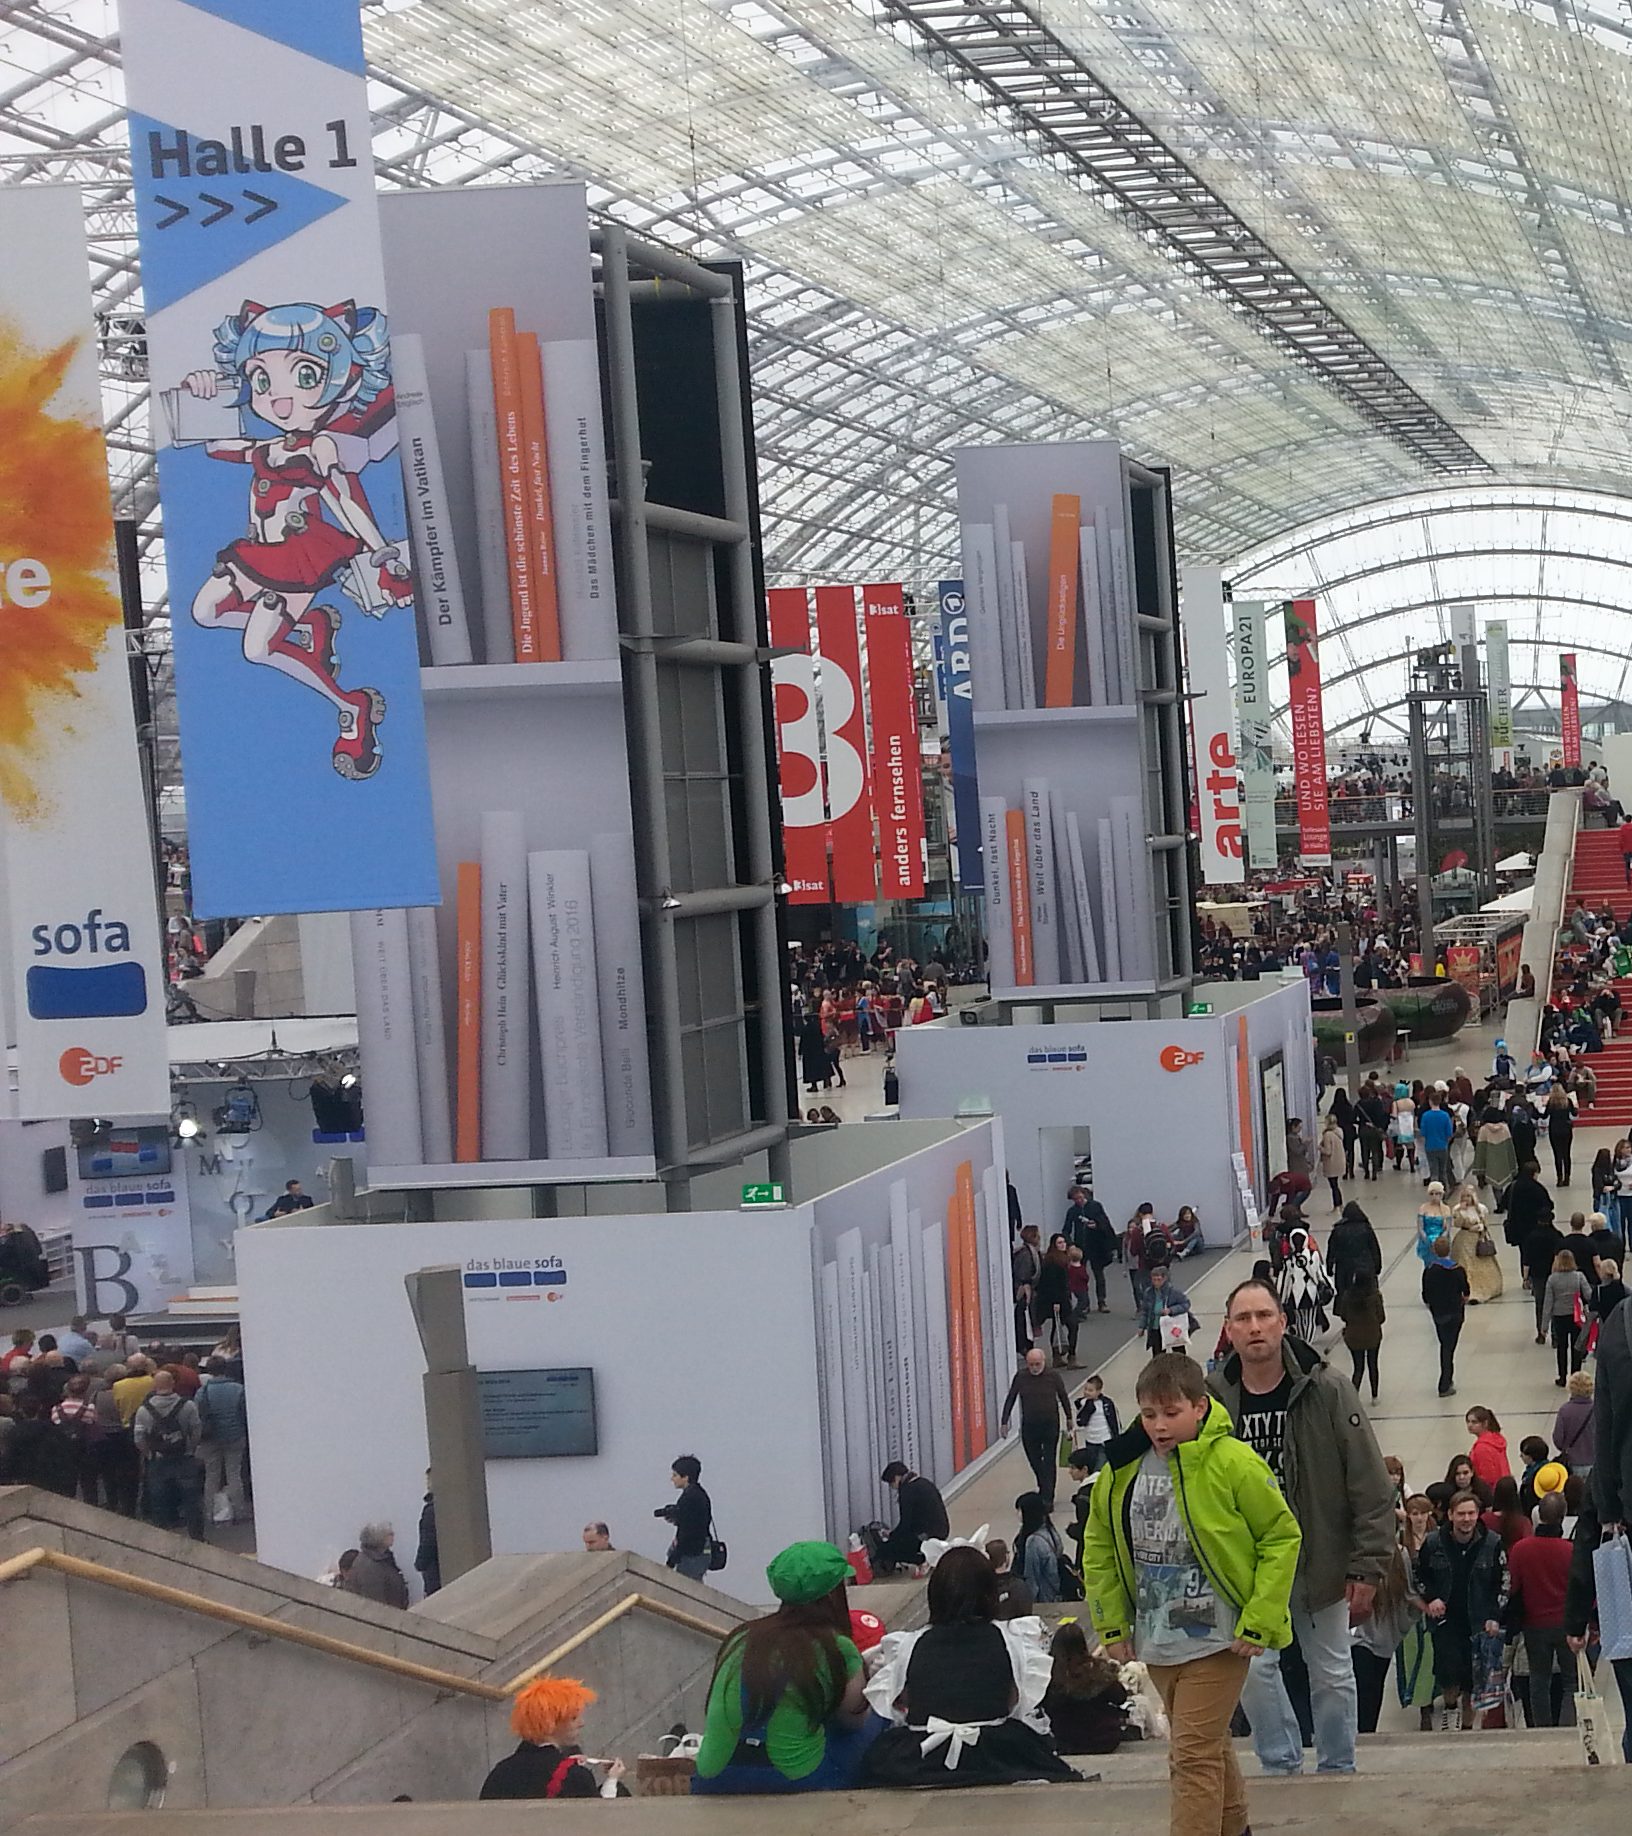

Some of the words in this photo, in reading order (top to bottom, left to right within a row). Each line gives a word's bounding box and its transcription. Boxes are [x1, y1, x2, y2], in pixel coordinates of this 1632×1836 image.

[148, 125, 306, 179] Halle
[326, 119, 358, 169] 1
[506, 411, 518, 452] Lebens
[576, 416, 590, 471] Fingerhut
[412, 437, 430, 497] Vatikan
[510, 454, 519, 474] des
[510, 479, 520, 502] Zeit
[580, 474, 592, 499] dem
[420, 500, 434, 522] im
[582, 502, 593, 521] mit
[514, 503, 525, 553] schönste
[425, 524, 447, 594] Kämpfer
[516, 555, 527, 572] die
[586, 525, 599, 575] Mädchen
[516, 573, 528, 588] ist
[588, 578, 600, 600] Das
[438, 599, 452, 626] Der
[517, 591, 532, 632] Jugend
[520, 634, 533, 653] Die
[1238, 615, 1257, 704] EUROPA21
[1295, 704, 1308, 745] LESEN
[1306, 686, 1322, 759] LIEBSTEN?
[1493, 687, 1509, 743] BÜCHER
[887, 735, 904, 818] fernsehen
[1298, 748, 1310, 775] WO
[1311, 761, 1323, 785] AM
[1030, 791, 1040, 818] Land
[1206, 731, 1245, 860] arte
[1301, 779, 1312, 811] UND
[1313, 788, 1325, 811] SIE
[988, 813, 997, 842] Nacht
[1032, 821, 1041, 840] das
[893, 819, 911, 887] anders
[989, 845, 999, 865] fast
[1033, 843, 1043, 870] über
[496, 882, 508, 911] Vater
[545, 872, 556, 911] Winkler
[992, 868, 1001, 905] Dunkel,
[1035, 872, 1045, 895] Weit
[32, 909, 131, 956] sofa
[496, 911, 506, 931] mit
[548, 913, 560, 948] August
[564, 900, 579, 935] 2016
[495, 932, 508, 990] Glückskind
[550, 950, 562, 989] Heinrich
[495, 995, 507, 1016] Hein
[615, 967, 628, 1030] Mondhitze
[495, 1019, 508, 1067] Christoph
[1068, 1044, 1085, 1053] sofa
[86, 1181, 108, 1194] das
[110, 1181, 143, 1193] blaue
[146, 1179, 171, 1191] sofa
[466, 1258, 490, 1271] das
[493, 1257, 531, 1270] blaue
[534, 1255, 563, 1269] sofa
[73, 1244, 139, 1317] B
